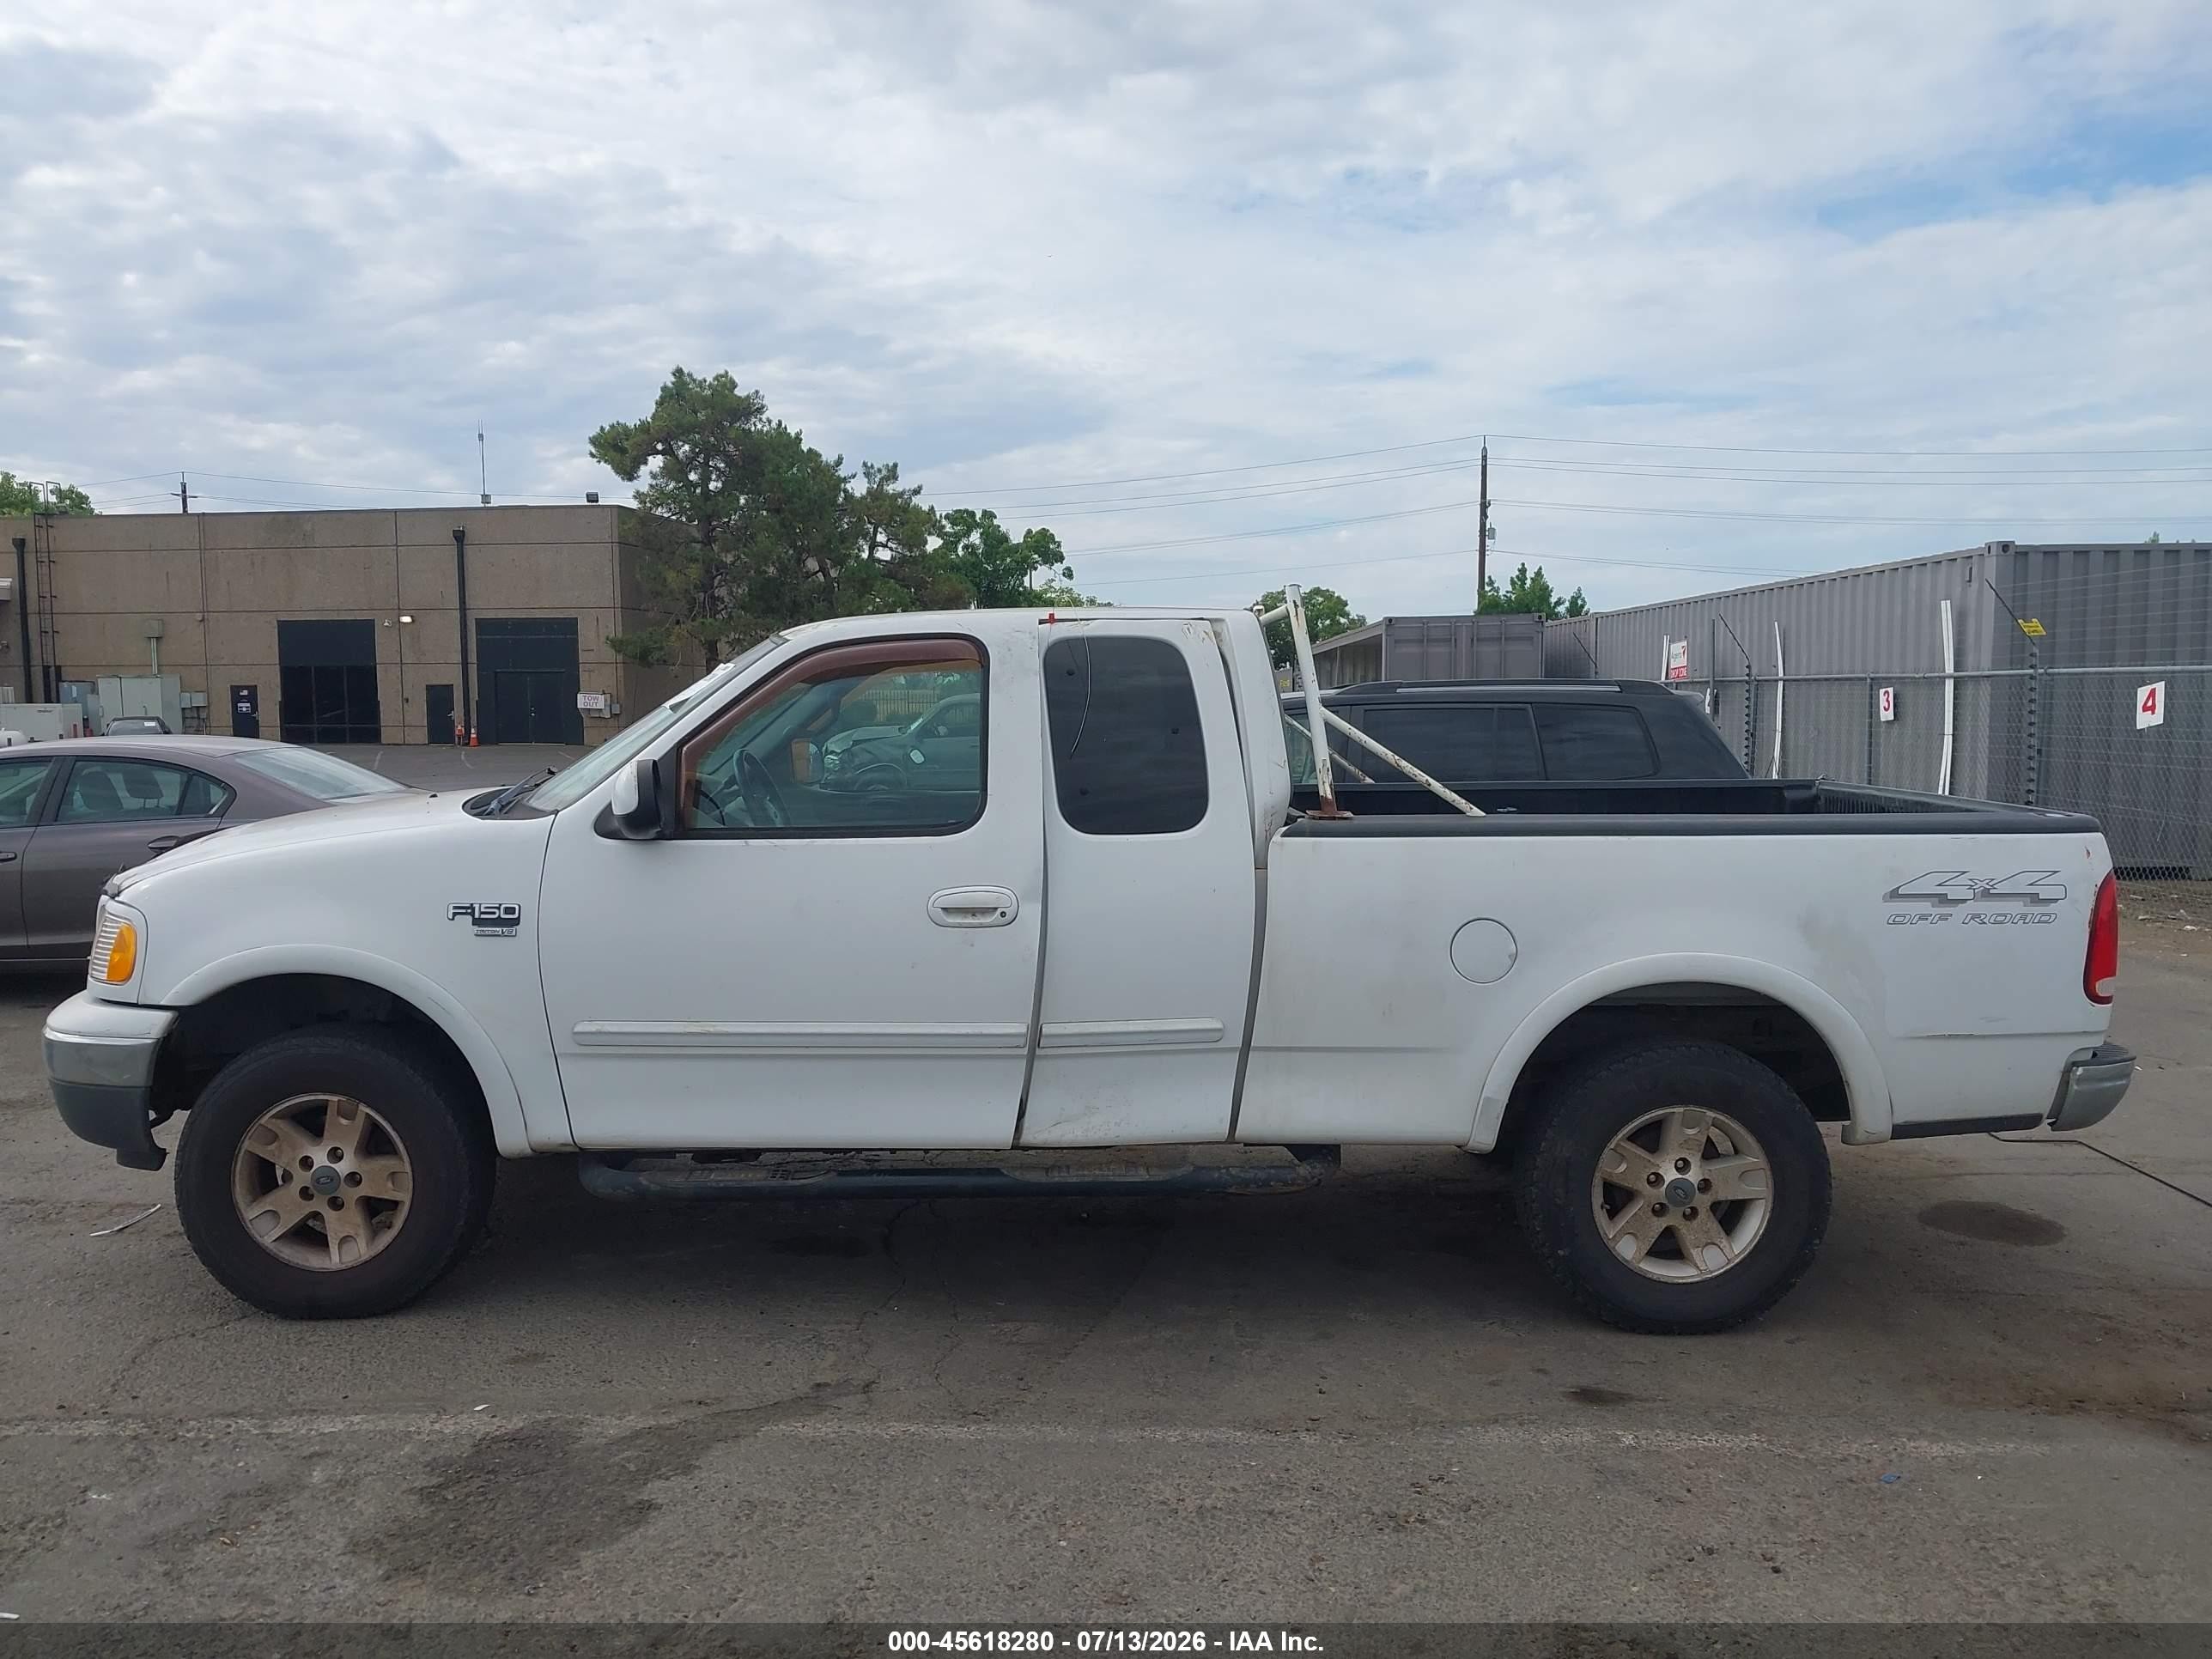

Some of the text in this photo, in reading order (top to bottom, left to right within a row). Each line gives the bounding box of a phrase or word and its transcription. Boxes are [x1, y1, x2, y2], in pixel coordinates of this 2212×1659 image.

[1883, 690, 1891, 712] 3
[2142, 687, 2156, 715] 4
[1887, 913, 2057, 925] OFF ROAD
